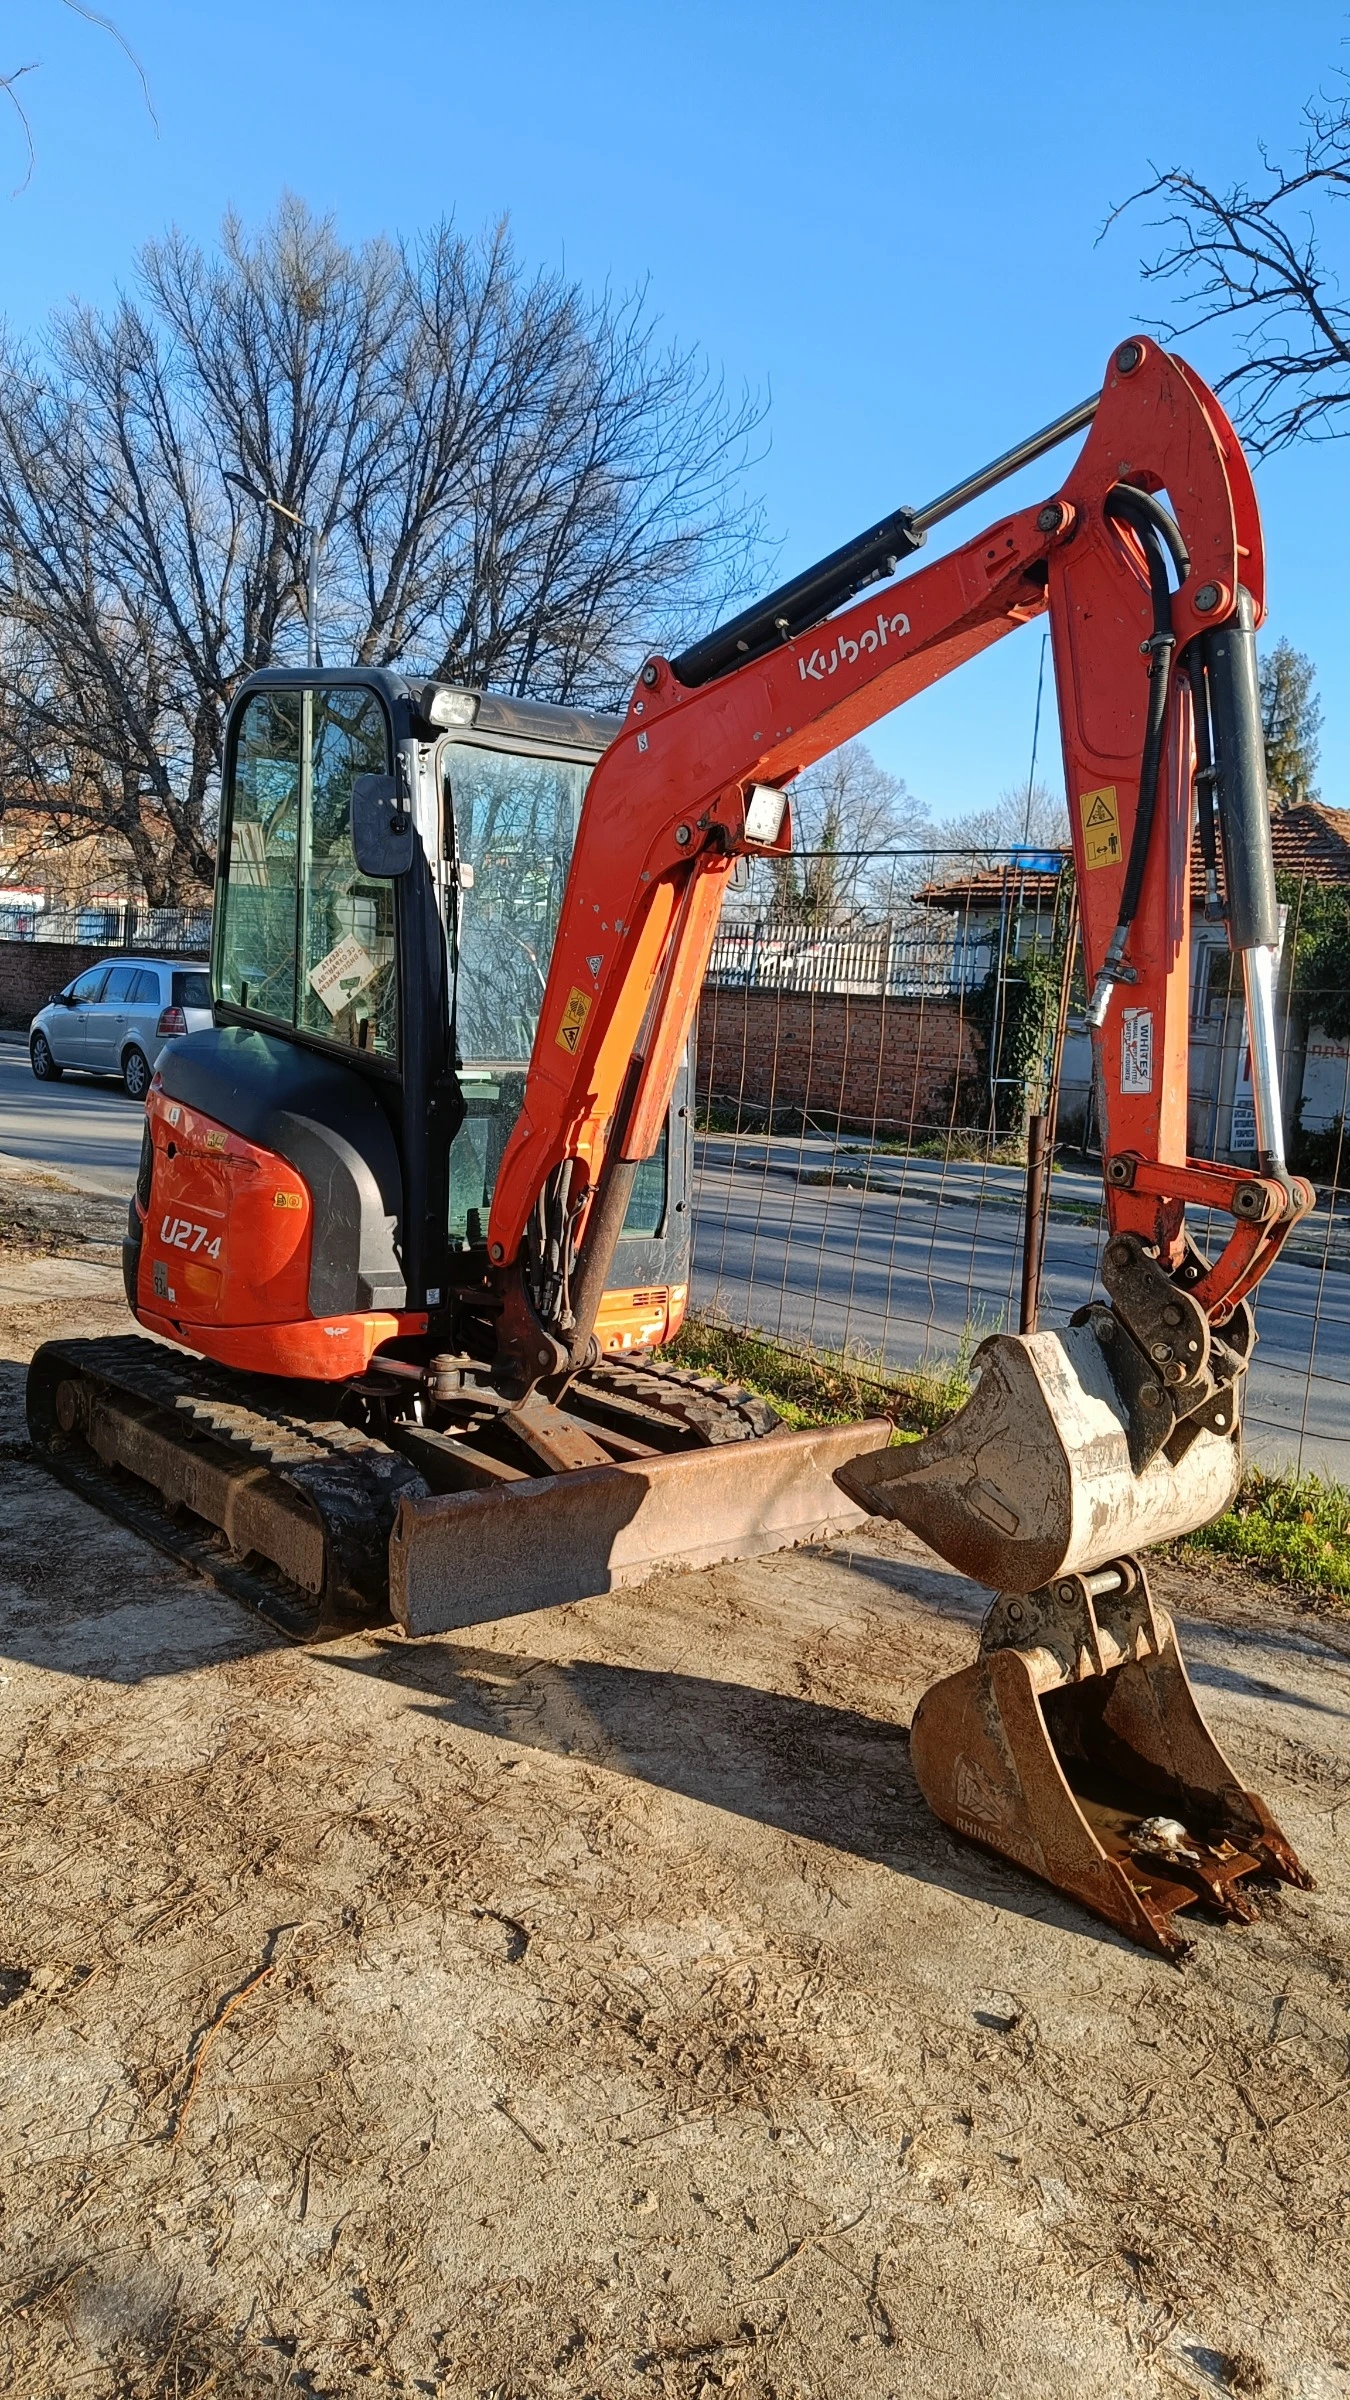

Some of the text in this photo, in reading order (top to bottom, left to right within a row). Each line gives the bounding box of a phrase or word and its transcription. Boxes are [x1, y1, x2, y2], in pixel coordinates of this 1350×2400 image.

[798, 613, 911, 681] Kubota
[1140, 1024, 1149, 1077] WHITES
[160, 1215, 222, 1260] U27-4
